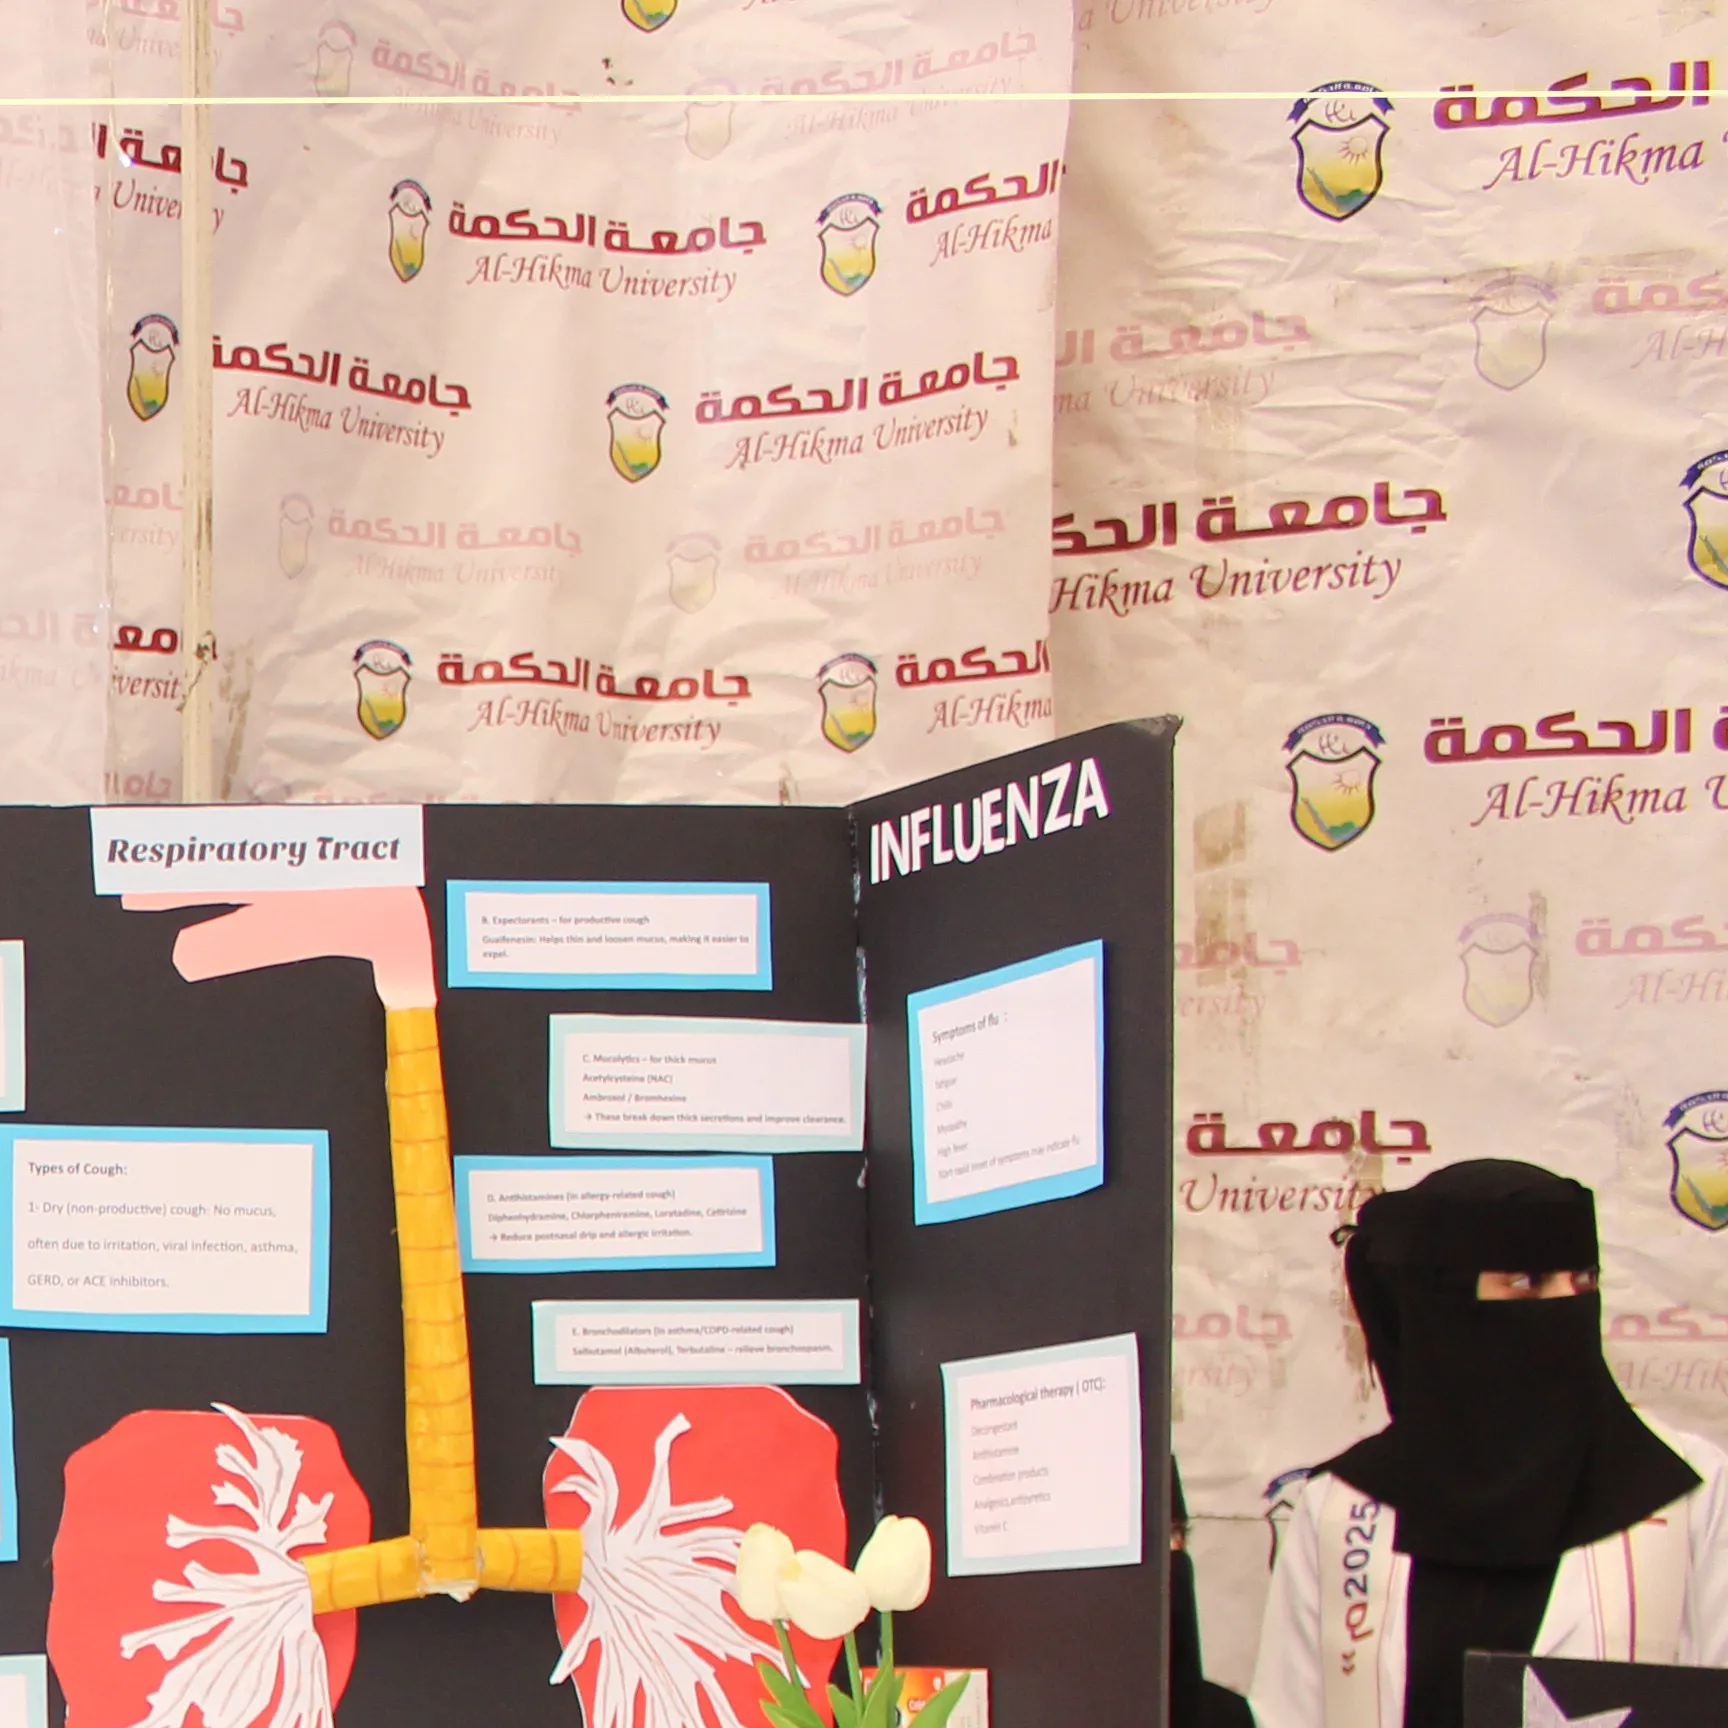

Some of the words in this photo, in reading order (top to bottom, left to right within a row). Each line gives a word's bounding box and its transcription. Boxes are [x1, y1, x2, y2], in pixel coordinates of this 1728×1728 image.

[1433, 60, 1711, 131] الحكمة
[1482, 133, 1705, 192] Al-Hikma
[905, 159, 1060, 225] الحكمة
[448, 201, 596, 247] الحكمة
[604, 216, 767, 256] جامعة
[929, 214, 1053, 268] Al-Hikma
[466, 255, 591, 289] Al-Hikma
[599, 266, 737, 302] University
[349, 357, 472, 416] جامعة
[695, 378, 868, 426] الحكمة
[878, 352, 1021, 408] جامعة
[227, 387, 331, 432] Al-Hikma
[340, 404, 445, 459] University
[725, 434, 864, 470] Al-Hikma
[872, 403, 989, 454] University
[1196, 481, 1448, 544] جامعة
[1189, 548, 1403, 602] University
[437, 651, 591, 692] الحكمة
[595, 664, 752, 707] جامعة
[895, 640, 1051, 689] الحكمة
[467, 693, 590, 737] Al-Hikma
[595, 712, 722, 751] University
[927, 688, 1052, 735] Al-Hikma
[1423, 708, 1692, 765] الحكمة
[869, 757, 1111, 885] INFLUENZA
[1470, 774, 1688, 828] Al-Hikma
[107, 835, 308, 869] Respiratory
[316, 836, 401, 861] Tract
[1186, 1110, 1433, 1165] جامعة
[29, 1161, 64, 1177] Types
[67, 1162, 80, 1175] of
[83, 1162, 128, 1178] Cough:
[42, 1201, 64, 1216] Dry
[66, 1201, 168, 1218] (non-productive)
[213, 1203, 232, 1217] No
[233, 1206, 277, 1218] mucus,
[27, 1237, 59, 1251] often
[61, 1237, 85, 1251] due
[87, 1239, 101, 1251] to
[103, 1238, 160, 1253] irritation,
[162, 1239, 188, 1252] viral
[190, 1239, 248, 1254] infection,
[250, 1240, 299, 1255] asthma,
